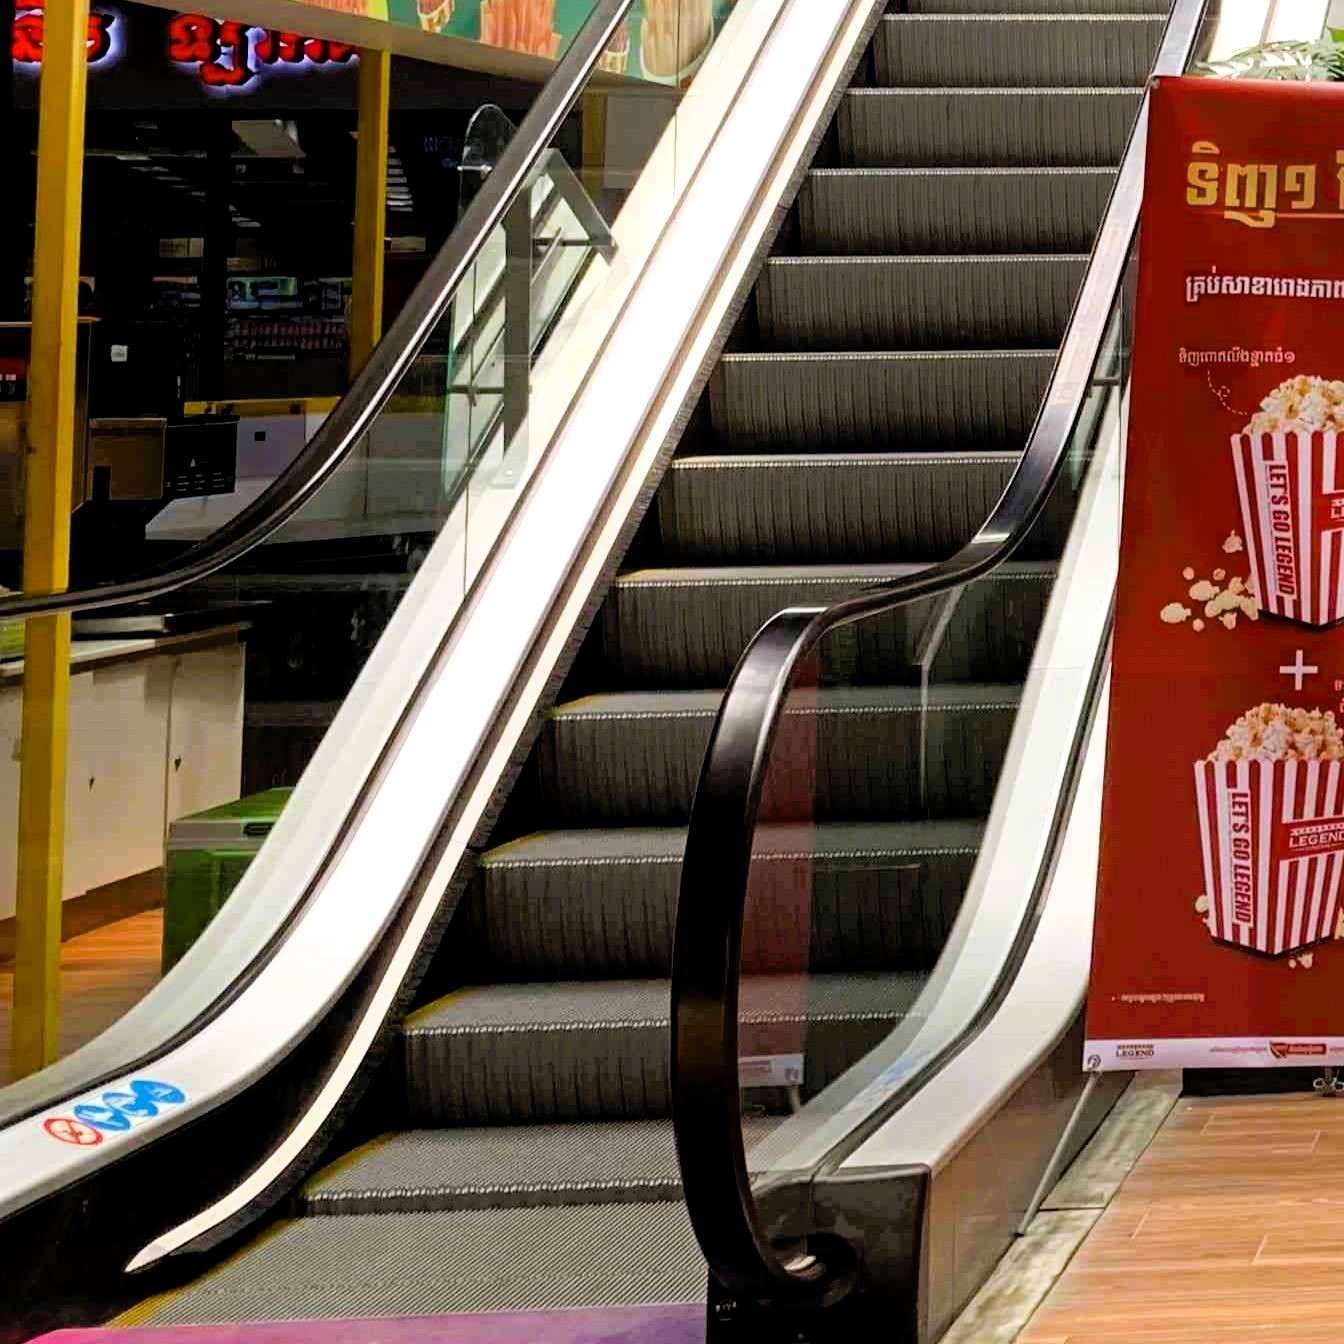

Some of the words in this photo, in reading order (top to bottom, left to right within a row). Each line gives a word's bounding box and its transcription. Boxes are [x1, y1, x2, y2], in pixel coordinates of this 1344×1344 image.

[1272, 510, 1290, 533] GO
[1275, 536, 1296, 595] LEGEND
[1232, 838, 1250, 860] GO
[1233, 864, 1251, 923] LEGEND
